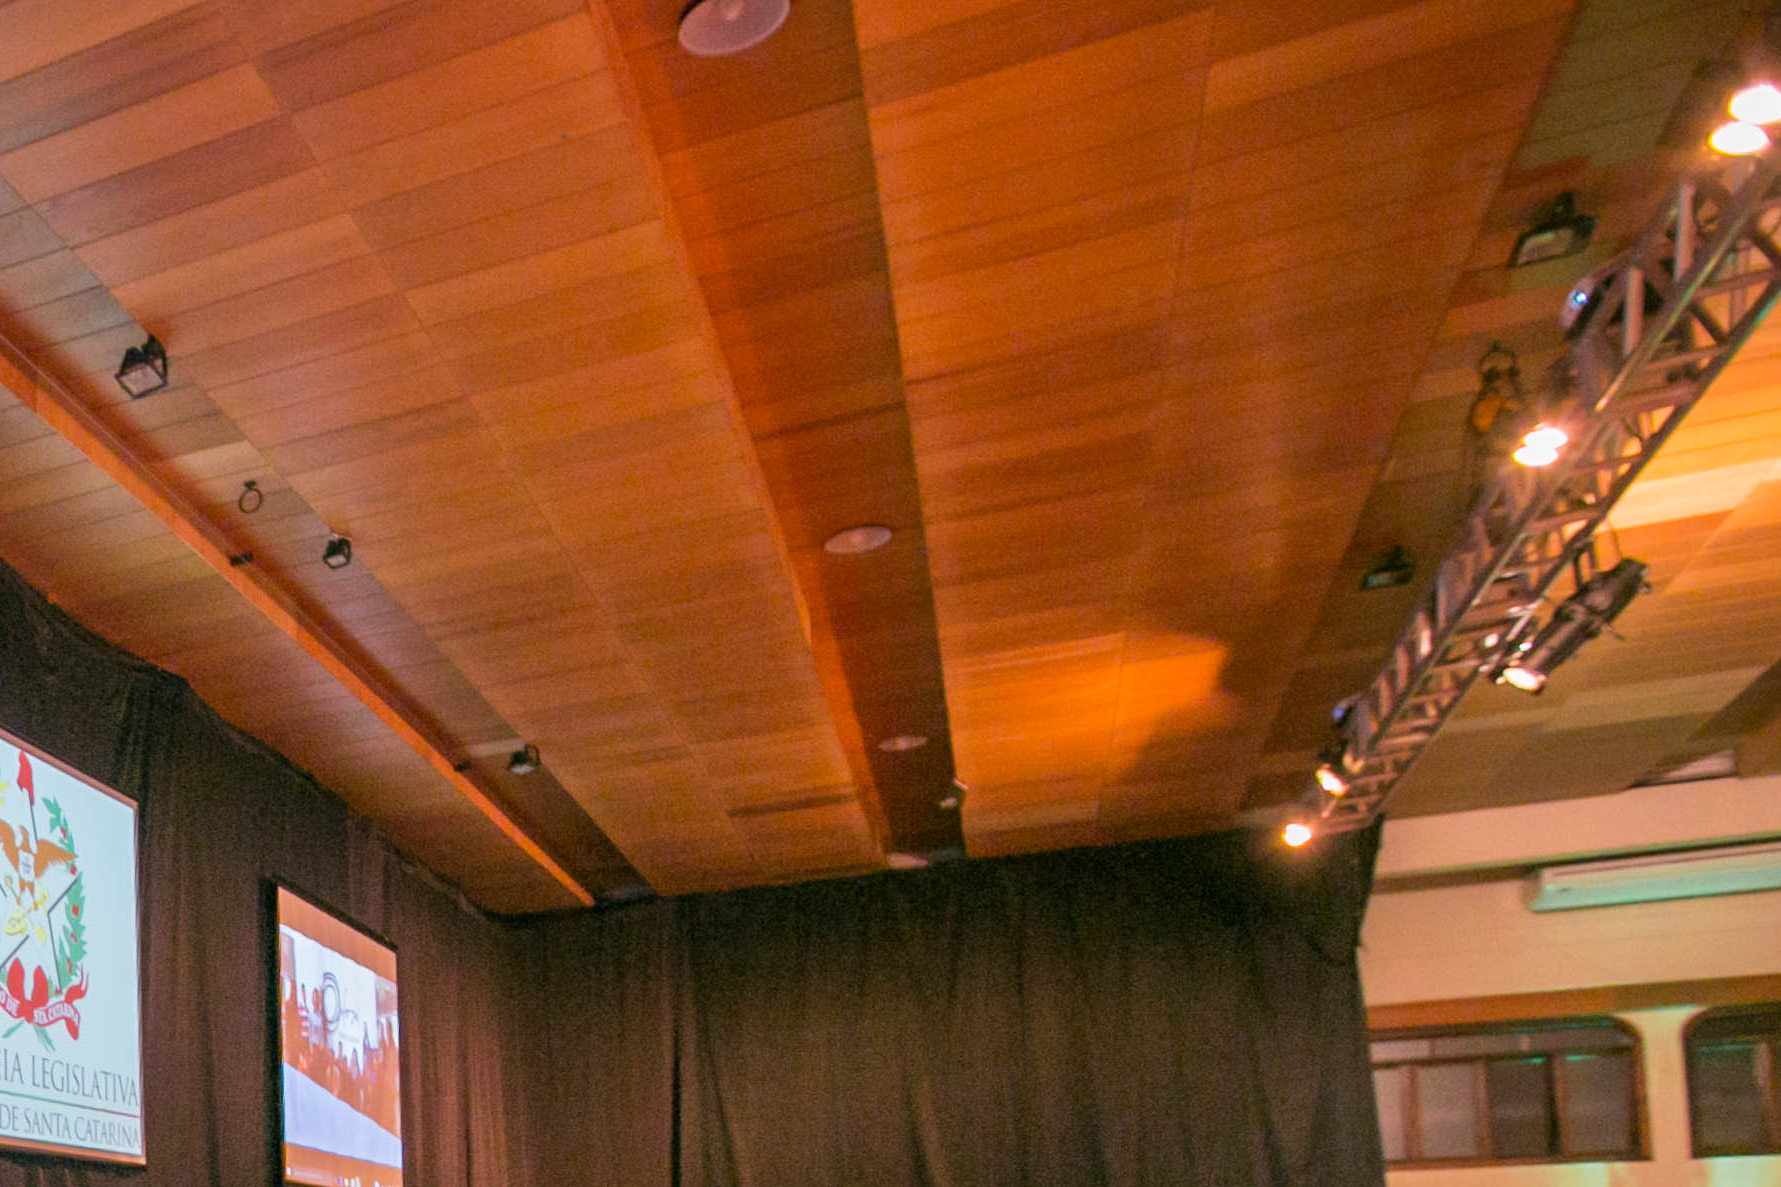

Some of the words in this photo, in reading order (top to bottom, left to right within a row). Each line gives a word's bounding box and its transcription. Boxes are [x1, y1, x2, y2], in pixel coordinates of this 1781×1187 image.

[32, 1055, 138, 1107] LEGISLATIVA
[0, 1103, 18, 1132] DE
[24, 1107, 71, 1141] SANTA
[75, 1116, 140, 1148] CATARINA
